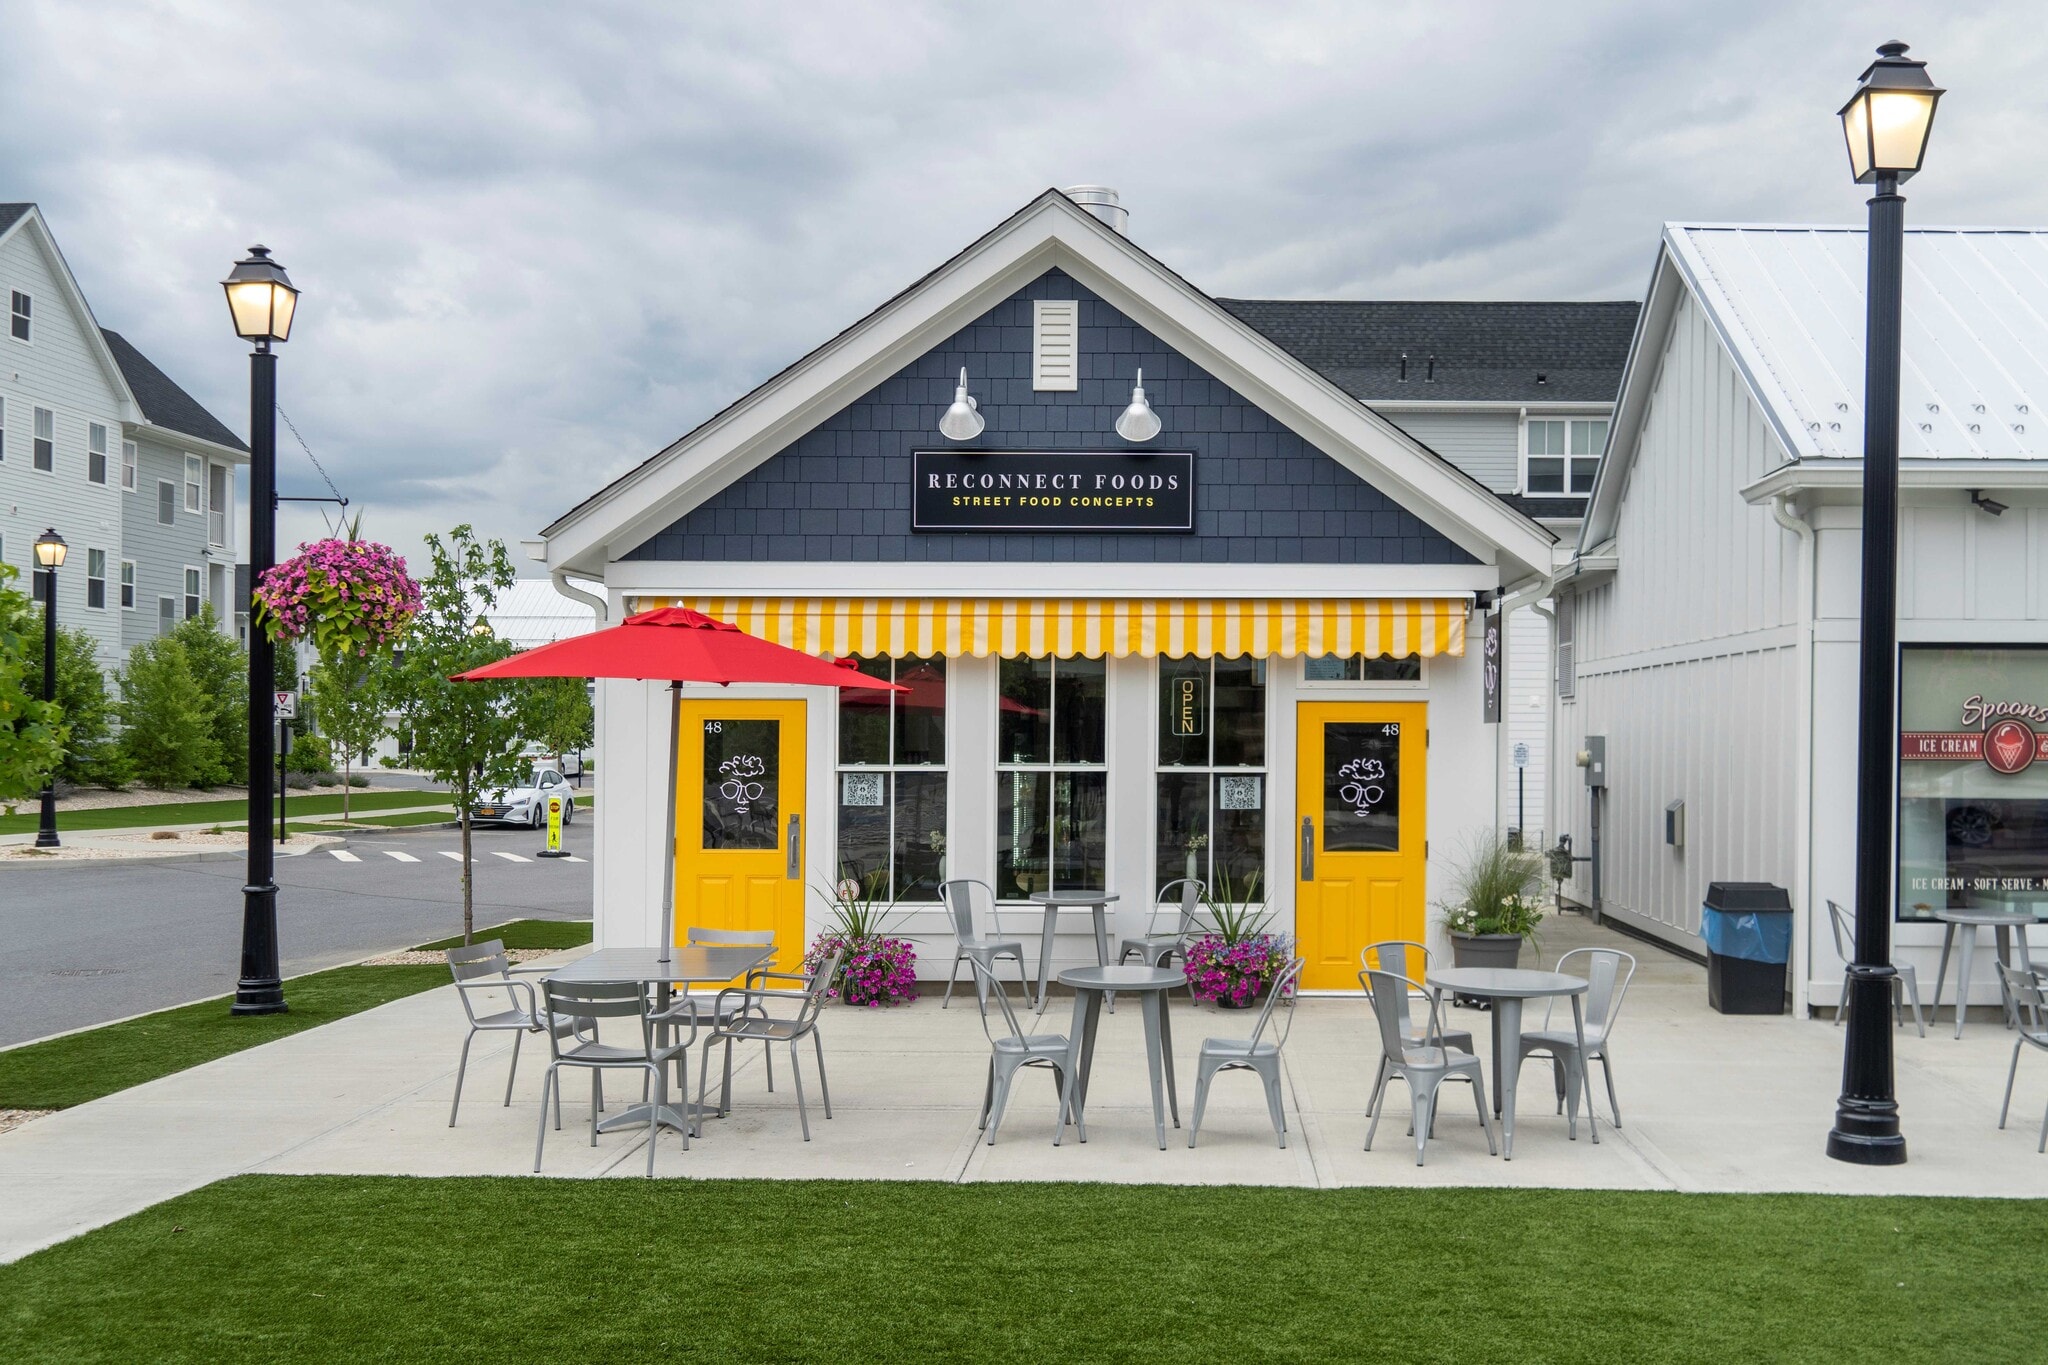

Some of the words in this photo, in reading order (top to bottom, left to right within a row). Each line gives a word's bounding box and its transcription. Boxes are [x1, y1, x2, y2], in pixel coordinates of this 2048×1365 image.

[928, 473, 1082, 489] RECONNECT
[1095, 474, 1178, 490] FOODS
[953, 496, 1011, 506] STREET
[1020, 497, 1061, 506] FOOD
[1070, 497, 1154, 507] CONCEPTS
[1182, 680, 1193, 733] OPEN
[1961, 694, 2048, 731] Spoons
[704, 721, 722, 734] 48
[1381, 723, 1399, 736] 48
[1919, 739, 1937, 752] ICE
[1941, 740, 1977, 752] CREAM
[1912, 878, 1927, 890] ICE
[1931, 878, 1964, 890] CREAM
[1974, 878, 1997, 891] SOFT
[2001, 878, 2032, 890] SERVE
